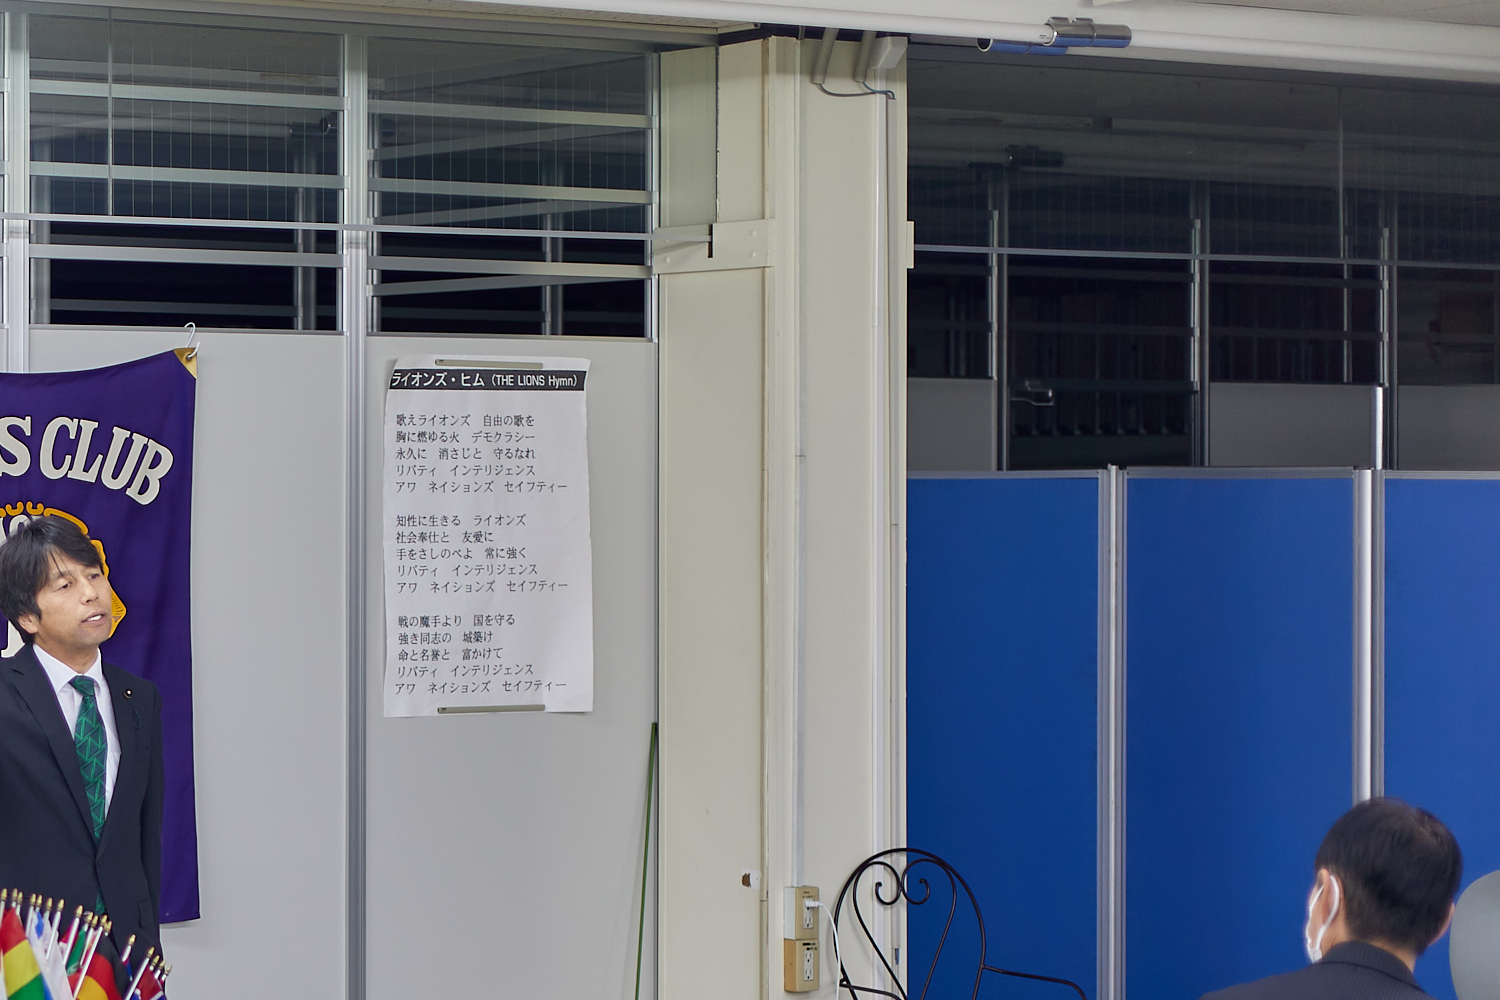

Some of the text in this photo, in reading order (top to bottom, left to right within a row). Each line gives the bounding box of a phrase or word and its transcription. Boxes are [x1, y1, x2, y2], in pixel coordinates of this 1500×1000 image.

[391, 371, 485, 387] ライオンズ・ヒム
[518, 374, 546, 387] LIONS
[396, 413, 535, 428] 歌えライオンズ 自由の歌を
[395, 430, 535, 444] 胸に燃ゆる火 デモクラシー
[395, 446, 536, 461] 永久に 消さじと 守るなれ
[39, 416, 174, 507] CLUB
[449, 464, 536, 477] インテリジェンス
[395, 480, 568, 494] アワ ネイションズ セイフティー
[395, 513, 527, 528] 知性に生きる ライオンズ
[395, 530, 494, 544] 社会奉仕と 友愛に
[396, 546, 526, 561] 手をさしのべよ 常に強く
[452, 563, 538, 577] インテリジェンス
[397, 579, 568, 594] アワ ネイションズ セイフティー
[473, 613, 516, 627] 国を守る
[398, 630, 494, 646] 強き同志の 城築け
[461, 647, 504, 661] 富かけて
[450, 663, 534, 678] インテリジェンス
[395, 679, 567, 695] アワ ネイションズ セイフティー
